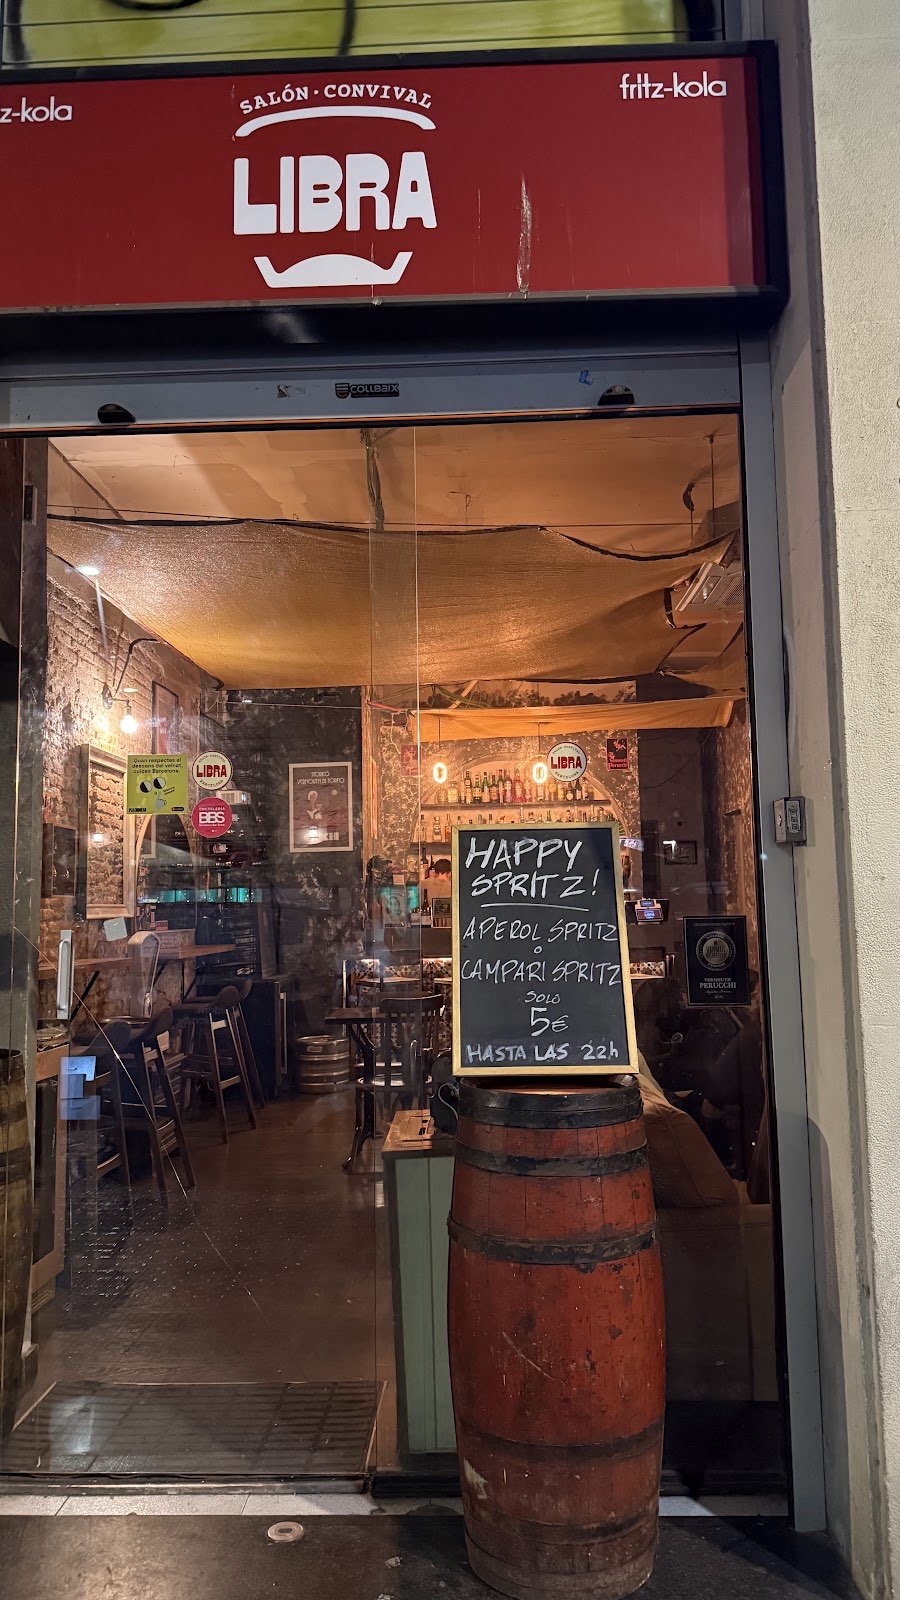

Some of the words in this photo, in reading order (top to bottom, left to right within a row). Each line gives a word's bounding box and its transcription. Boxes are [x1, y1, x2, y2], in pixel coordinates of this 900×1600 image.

[619, 70, 728, 100] fritz-kola
[240, 84, 309, 115] SALÓN
[323, 84, 433, 109] CONVIVAL
[233, 151, 438, 236] LIBRA
[196, 764, 228, 778] LIBRA
[551, 756, 582, 769] LIBRA
[198, 811, 226, 824] BBS
[464, 836, 583, 873] HAPPY
[462, 916, 541, 941] APEROL
[547, 919, 618, 943] SPRITZ
[460, 959, 546, 984] CAMPARI
[552, 961, 622, 986] SPRITZ
[699, 981, 737, 989] PERUCCHI
[524, 990, 561, 1004] SOLO
[529, 1007, 569, 1037] 5€
[465, 1043, 527, 1063] HASTA
[534, 1043, 569, 1061] LAS
[580, 1041, 619, 1061] 22h
